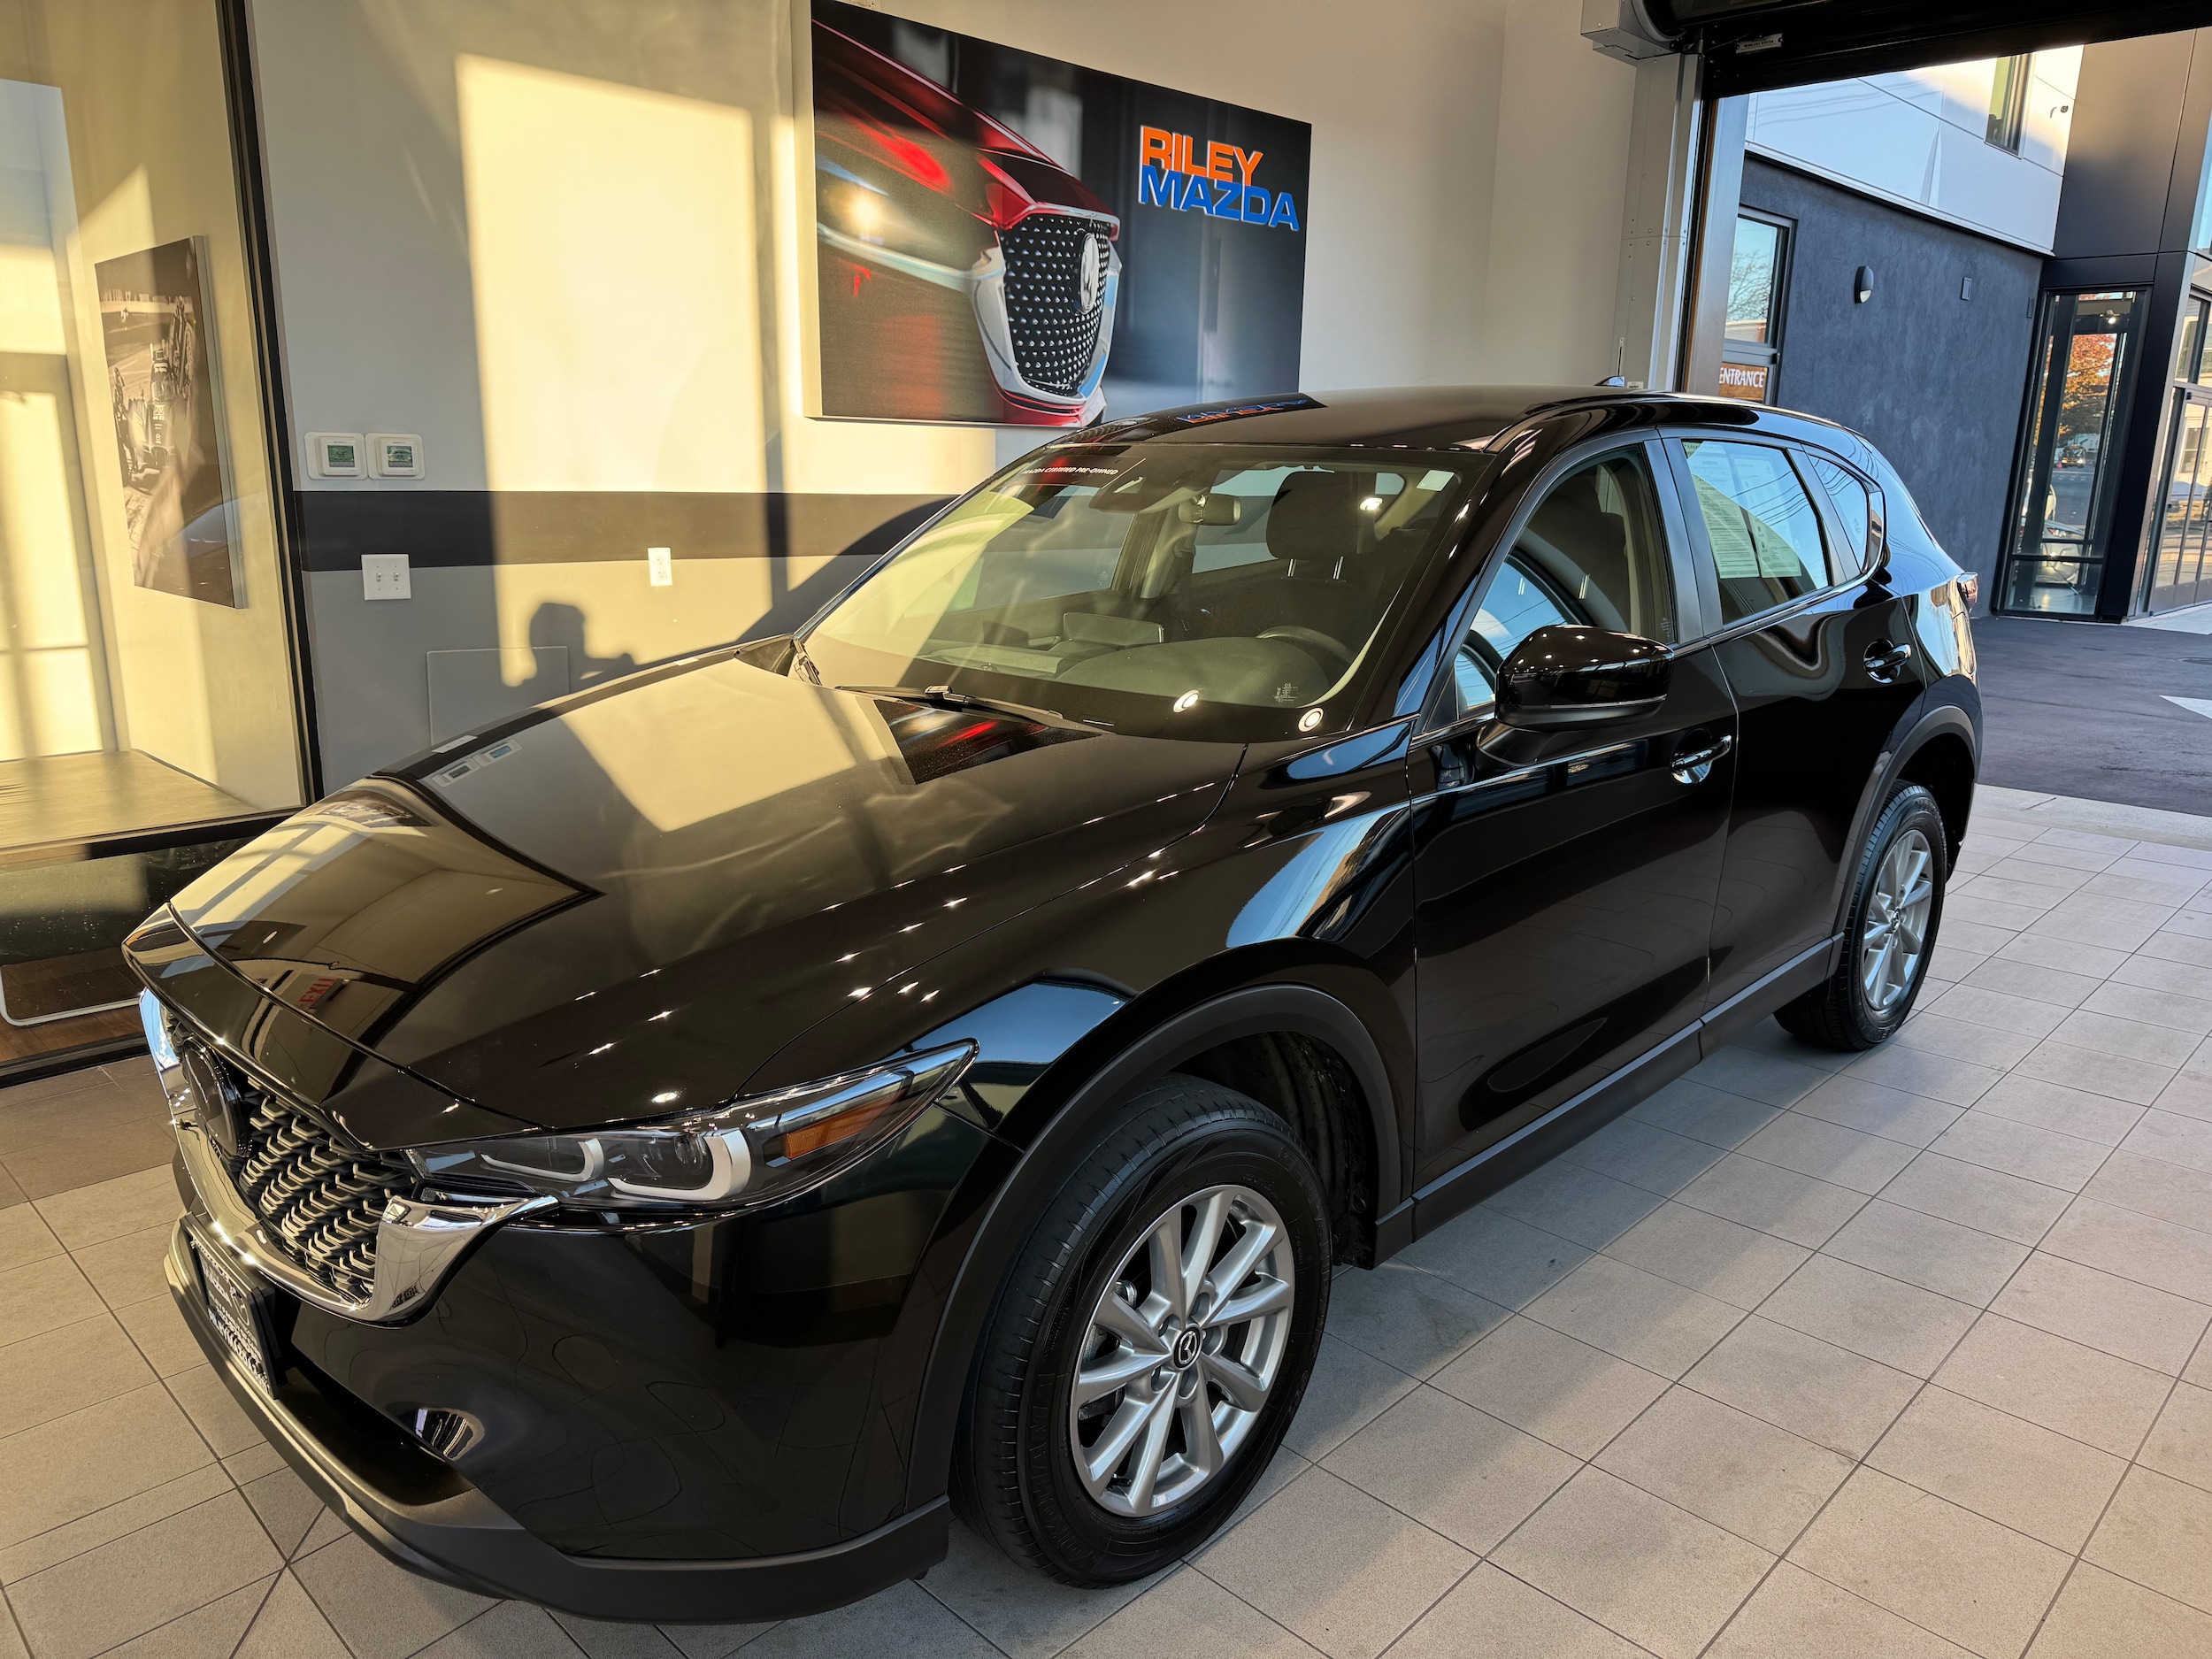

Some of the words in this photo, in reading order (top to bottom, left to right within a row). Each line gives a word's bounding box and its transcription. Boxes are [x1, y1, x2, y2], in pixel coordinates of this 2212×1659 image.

[1141, 125, 1263, 186] RILEY
[1138, 165, 1300, 231] MAZDA
[1719, 366, 1764, 388] ENTRANCE
